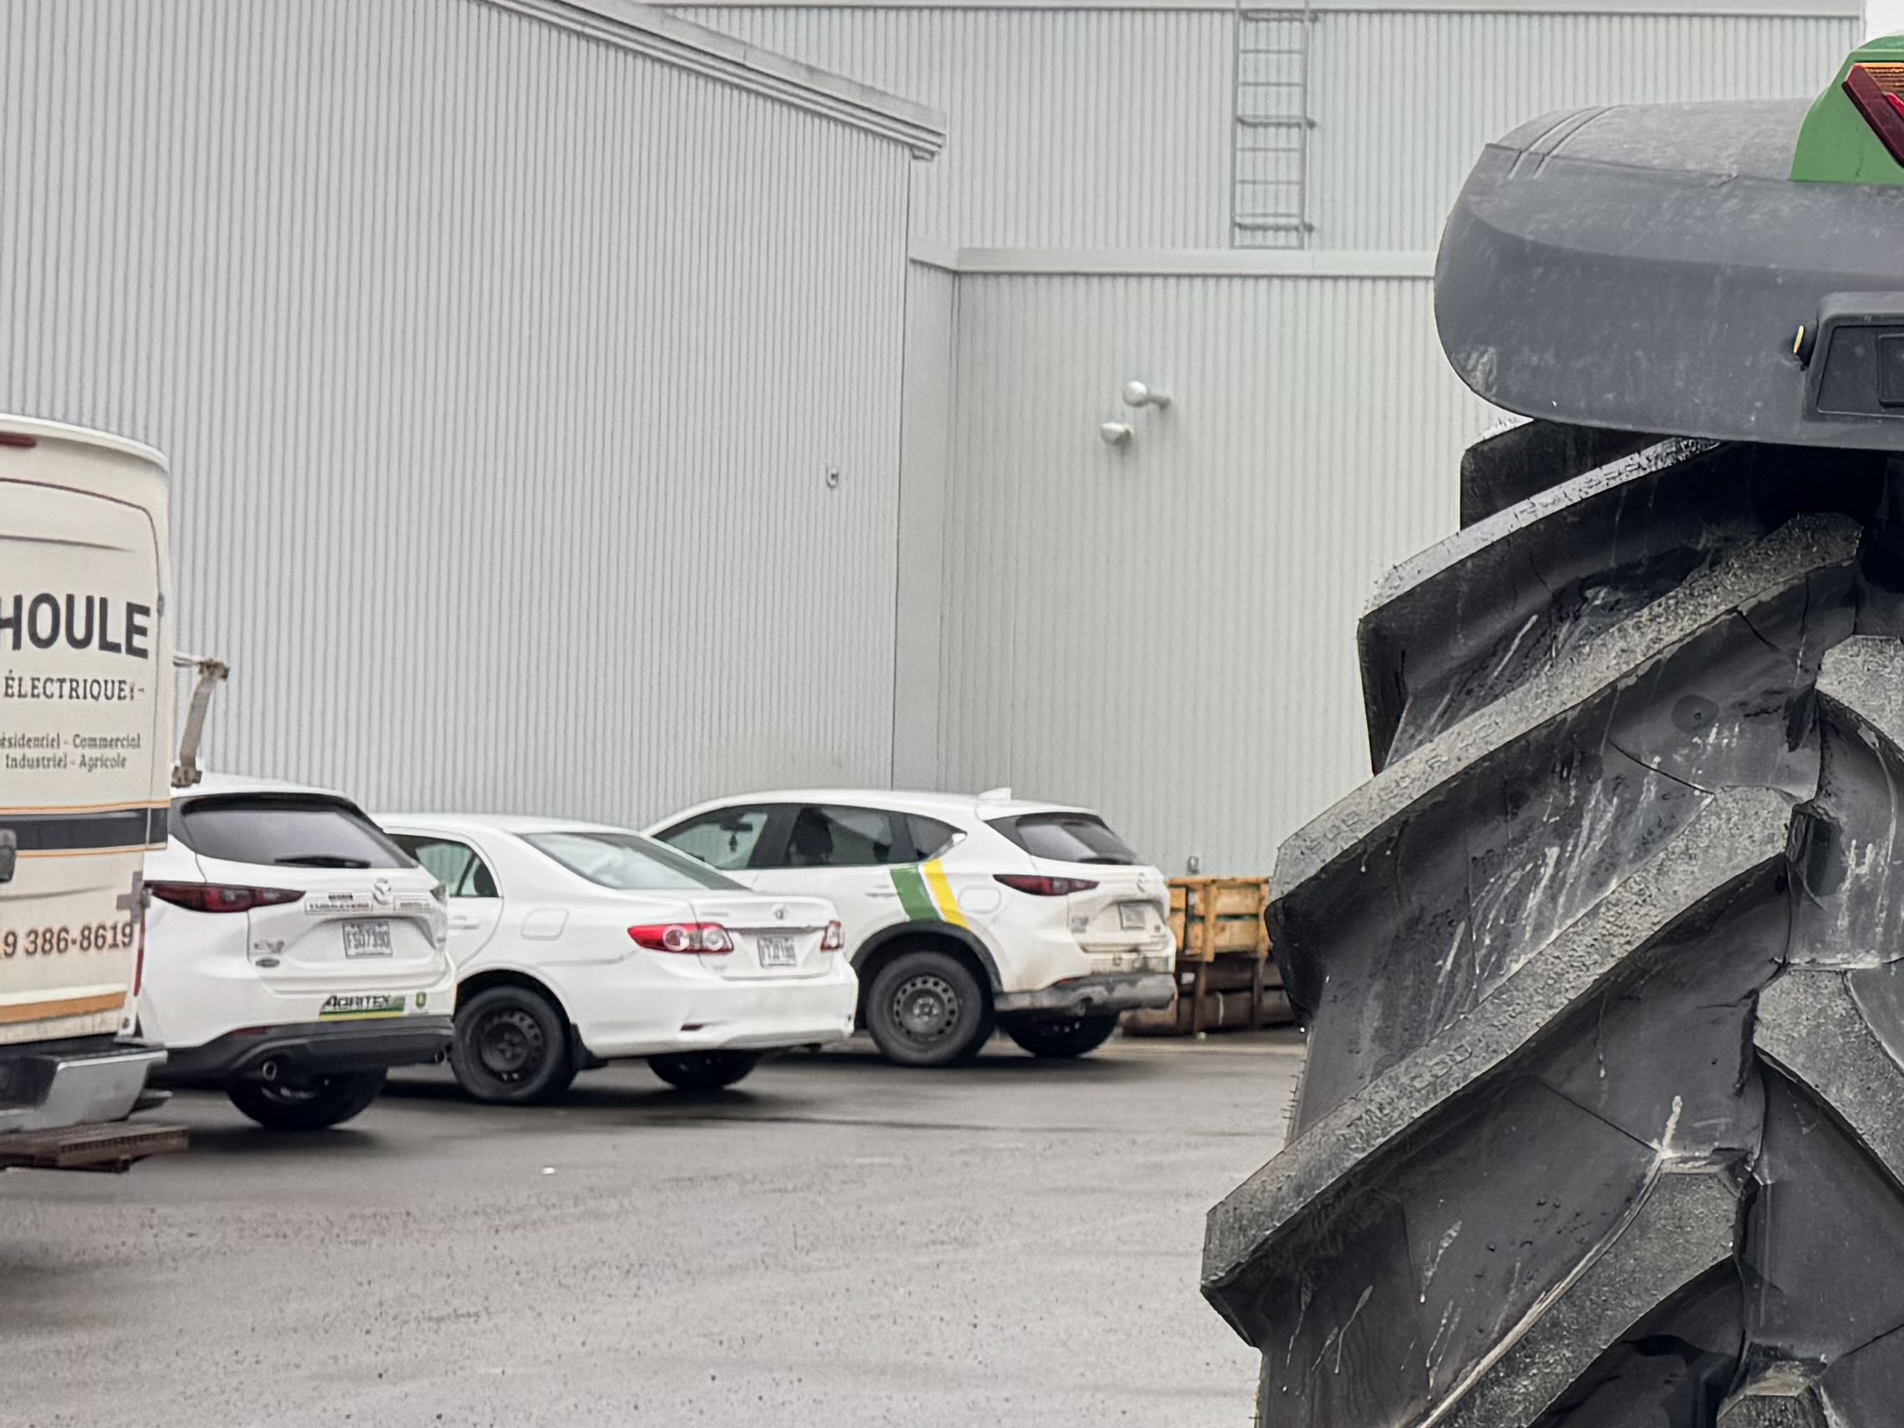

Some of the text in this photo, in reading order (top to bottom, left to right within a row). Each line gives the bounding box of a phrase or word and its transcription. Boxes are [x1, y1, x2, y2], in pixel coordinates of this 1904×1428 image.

[0, 593, 150, 659] HOULE
[4, 669, 127, 701] ÉLECTRIQUE
[6, 753, 67, 769] Industriel
[79, 753, 127, 772] Agricole
[25, 921, 134, 956] 386-8619
